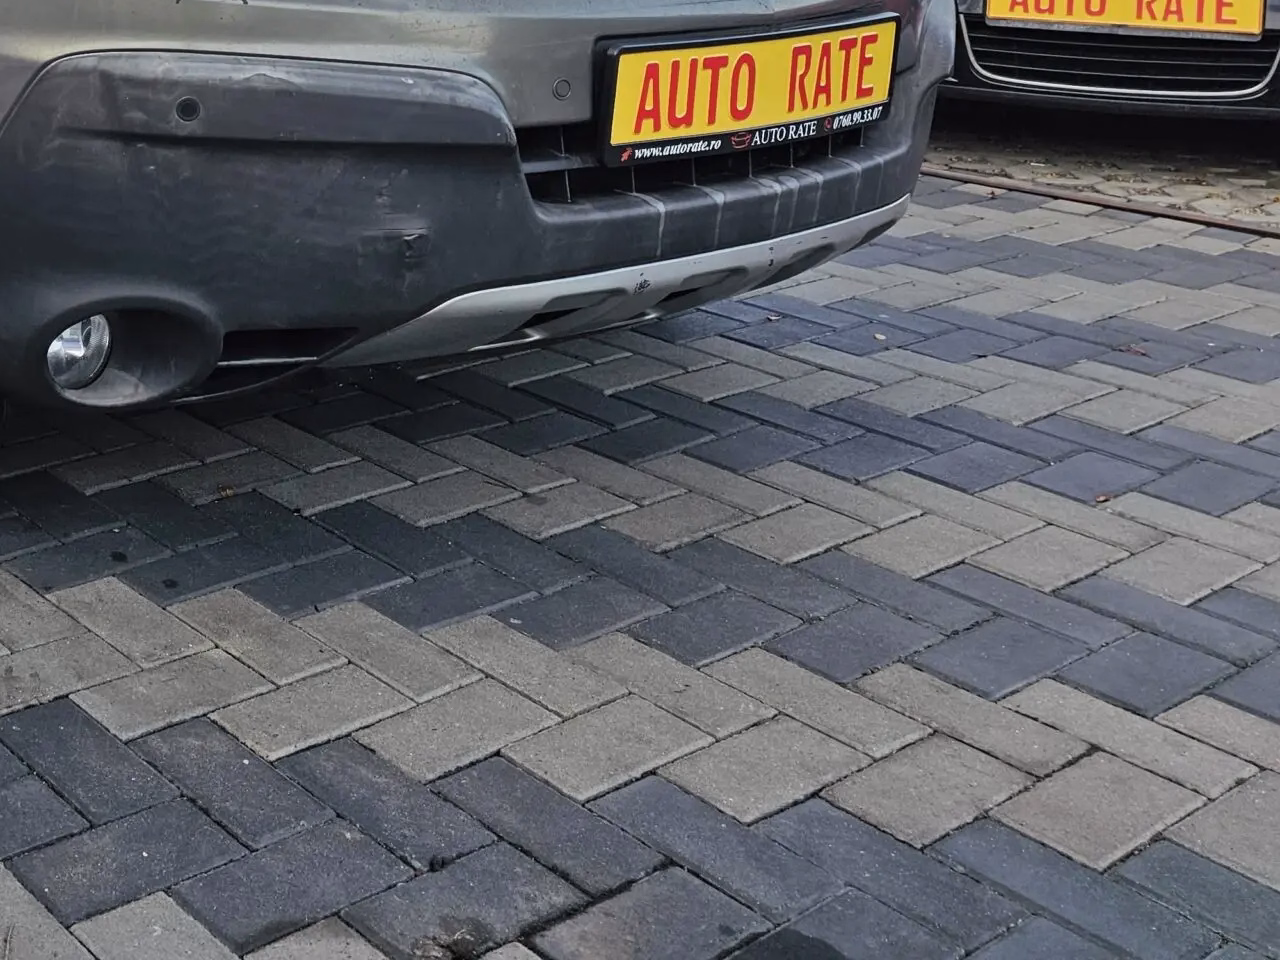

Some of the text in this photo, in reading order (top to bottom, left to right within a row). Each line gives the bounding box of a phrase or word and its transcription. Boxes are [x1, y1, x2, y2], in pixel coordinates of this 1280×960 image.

[633, 33, 879, 135] AUTO RATE
[633, 106, 883, 160] www.autorate.ro AUTO RATE 0760.99.33.07
